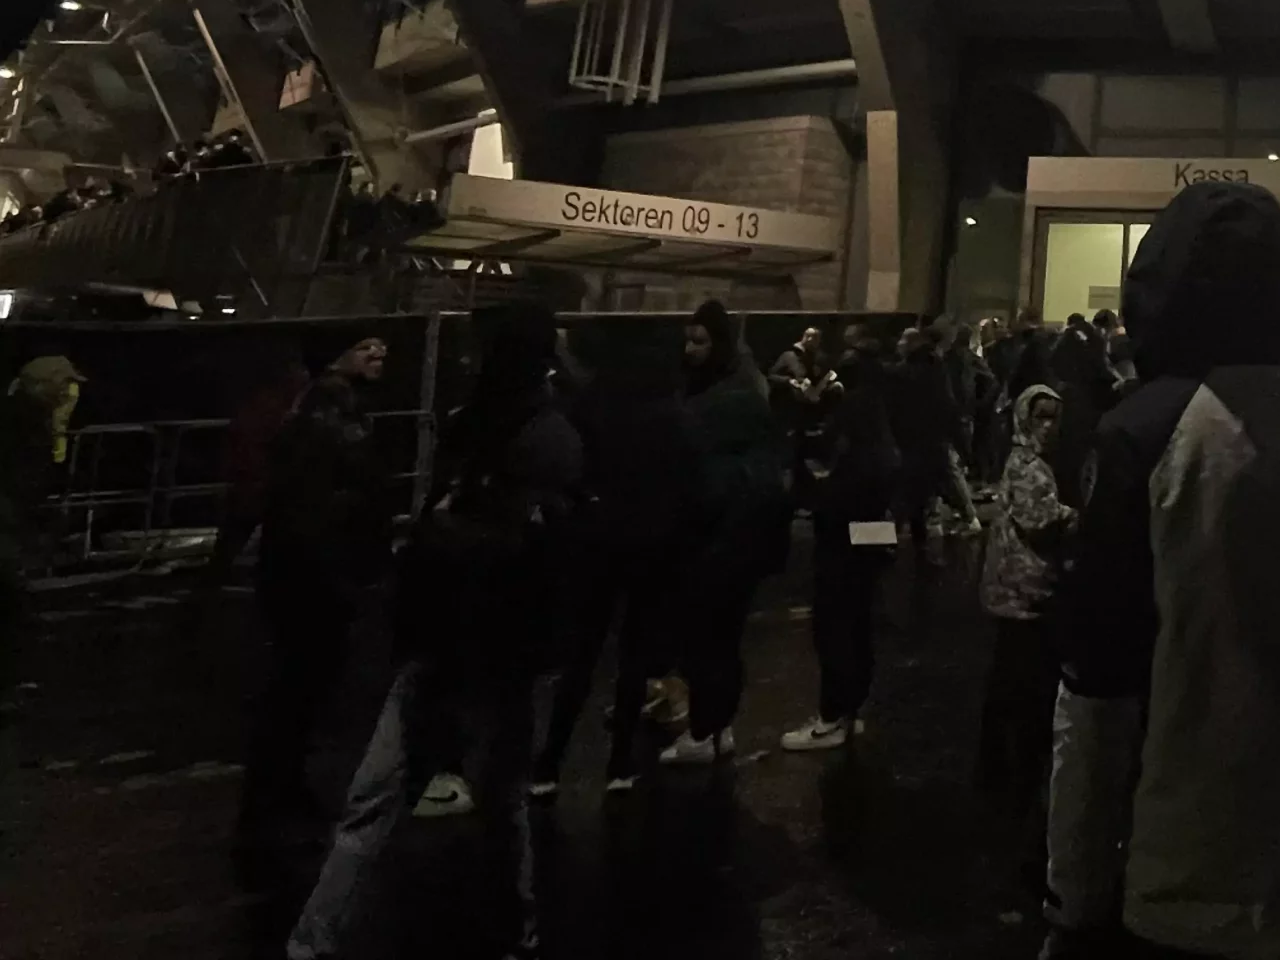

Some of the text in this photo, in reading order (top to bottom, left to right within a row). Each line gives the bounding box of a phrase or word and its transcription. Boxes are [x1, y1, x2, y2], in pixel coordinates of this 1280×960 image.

[1174, 162, 1249, 188] Kassa
[561, 191, 674, 231] Sektoren
[681, 205, 711, 234] 09
[735, 211, 760, 239] 13
